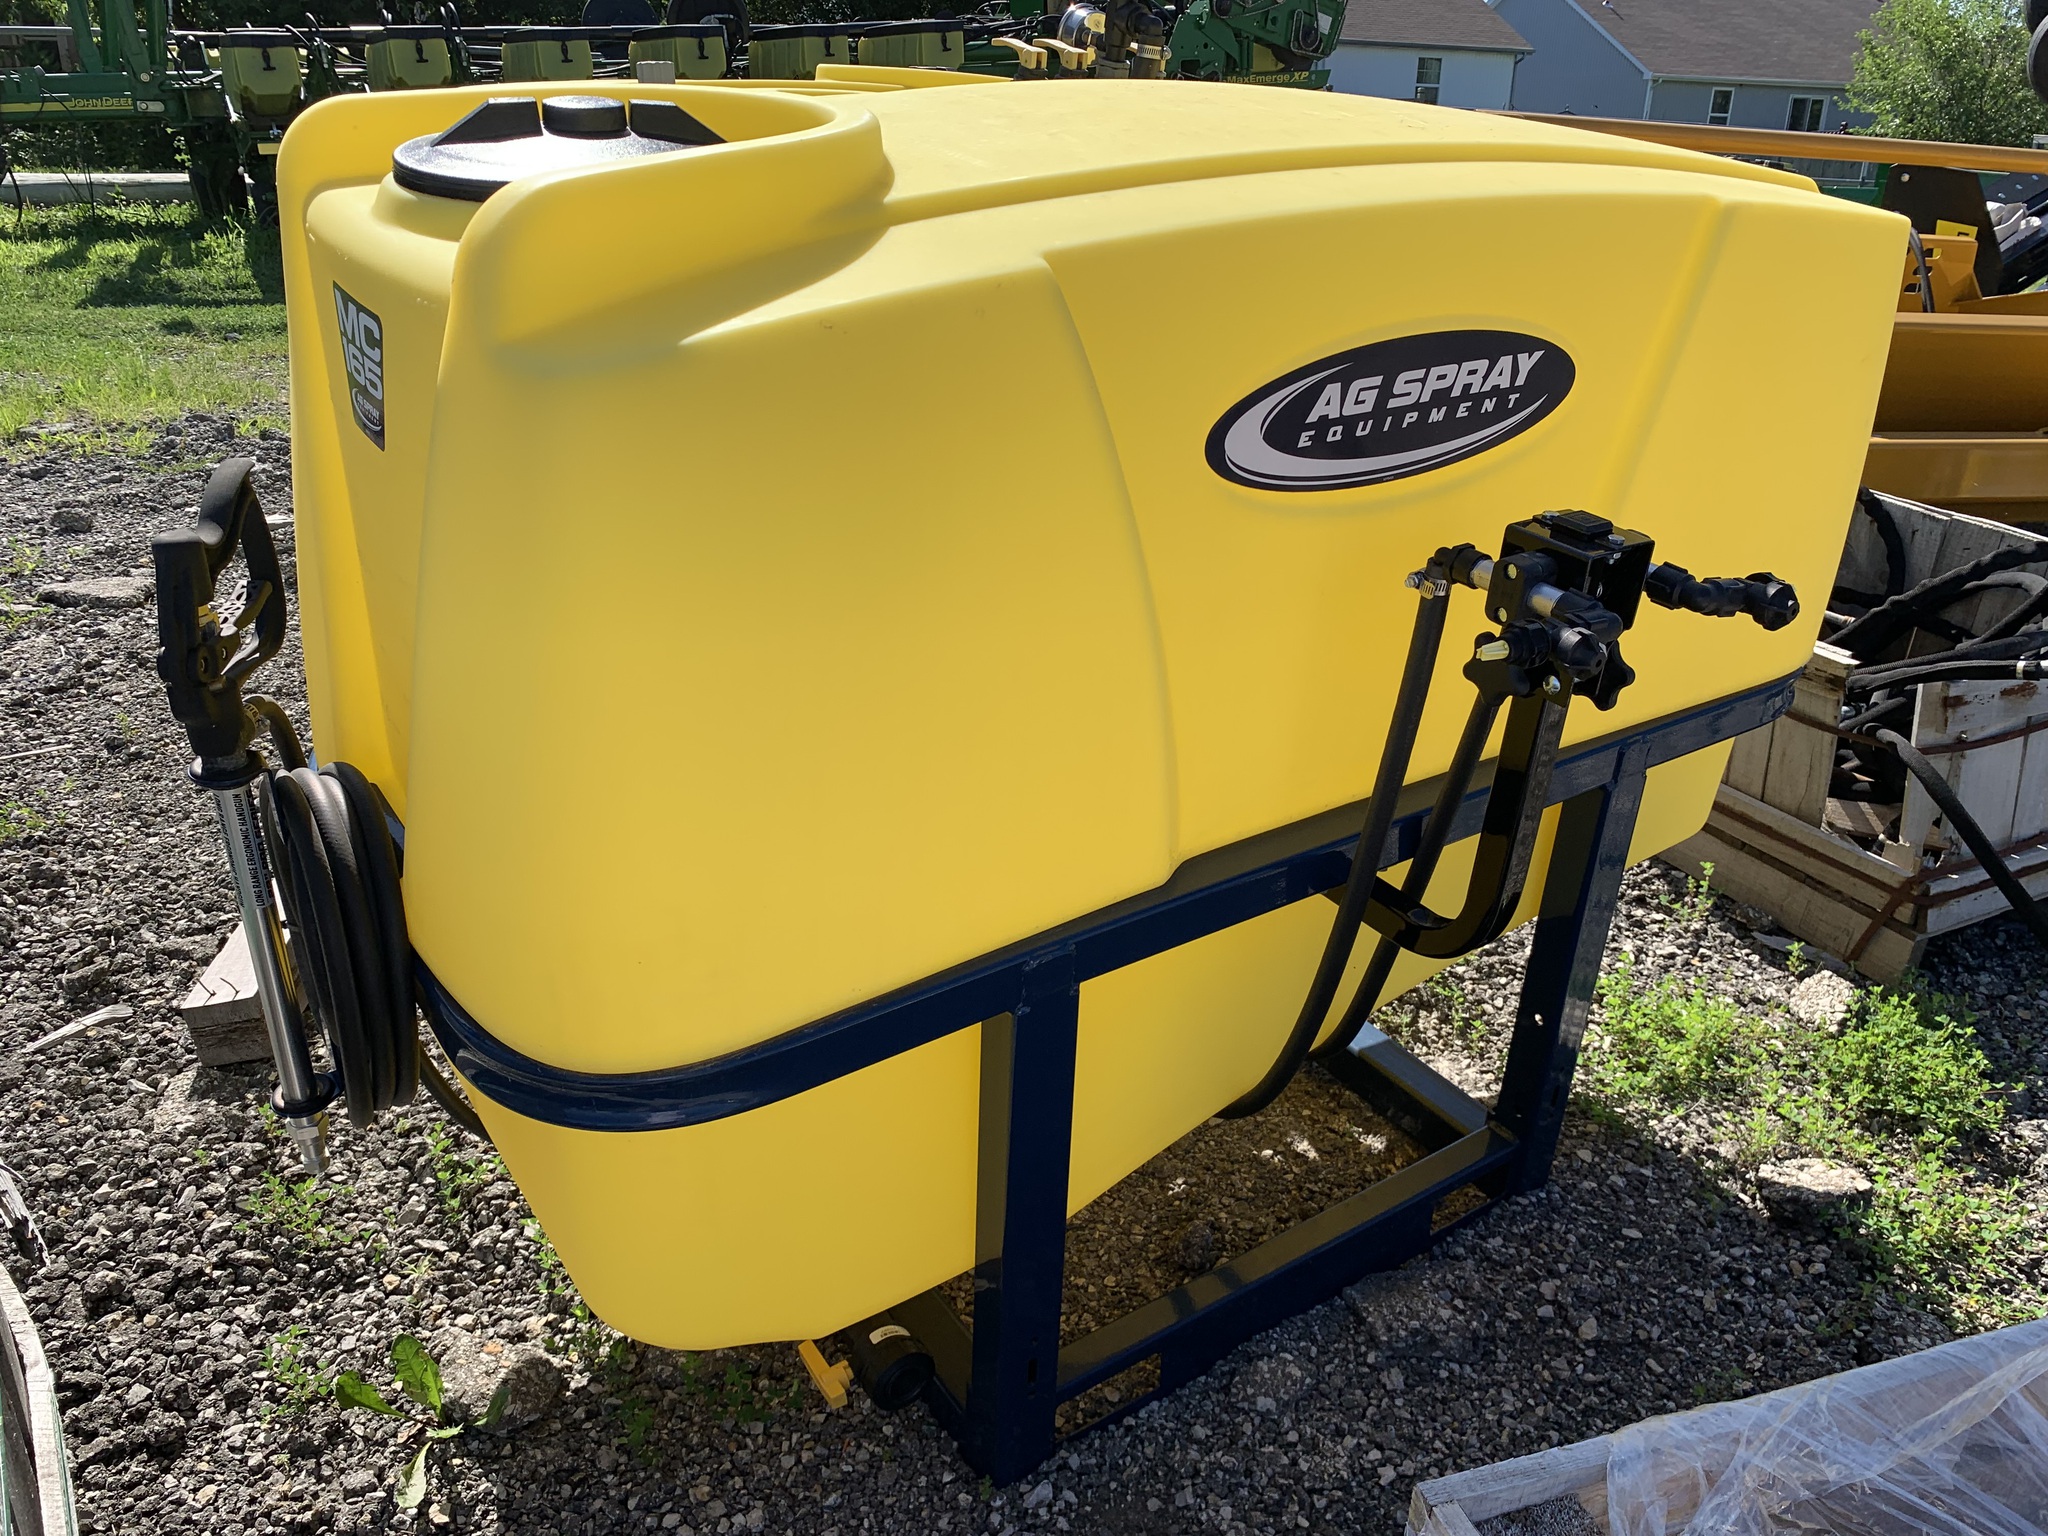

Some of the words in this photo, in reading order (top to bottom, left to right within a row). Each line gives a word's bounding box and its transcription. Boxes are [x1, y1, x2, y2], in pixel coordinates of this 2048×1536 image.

[1290, 71, 1309, 82] XP
[70, 97, 102, 108] JOHN
[102, 96, 133, 107] DEE
[334, 288, 381, 363] MC
[342, 336, 383, 400] 165
[1304, 375, 1384, 424] AG
[1387, 350, 1546, 409] SPRAY
[1297, 393, 1520, 449] EQUIPMENT
[232, 793, 249, 827] HANDGUN
[241, 827, 257, 866] ERGONOMIC
[248, 866, 261, 889] RANGE
[254, 889, 266, 907] LONG
